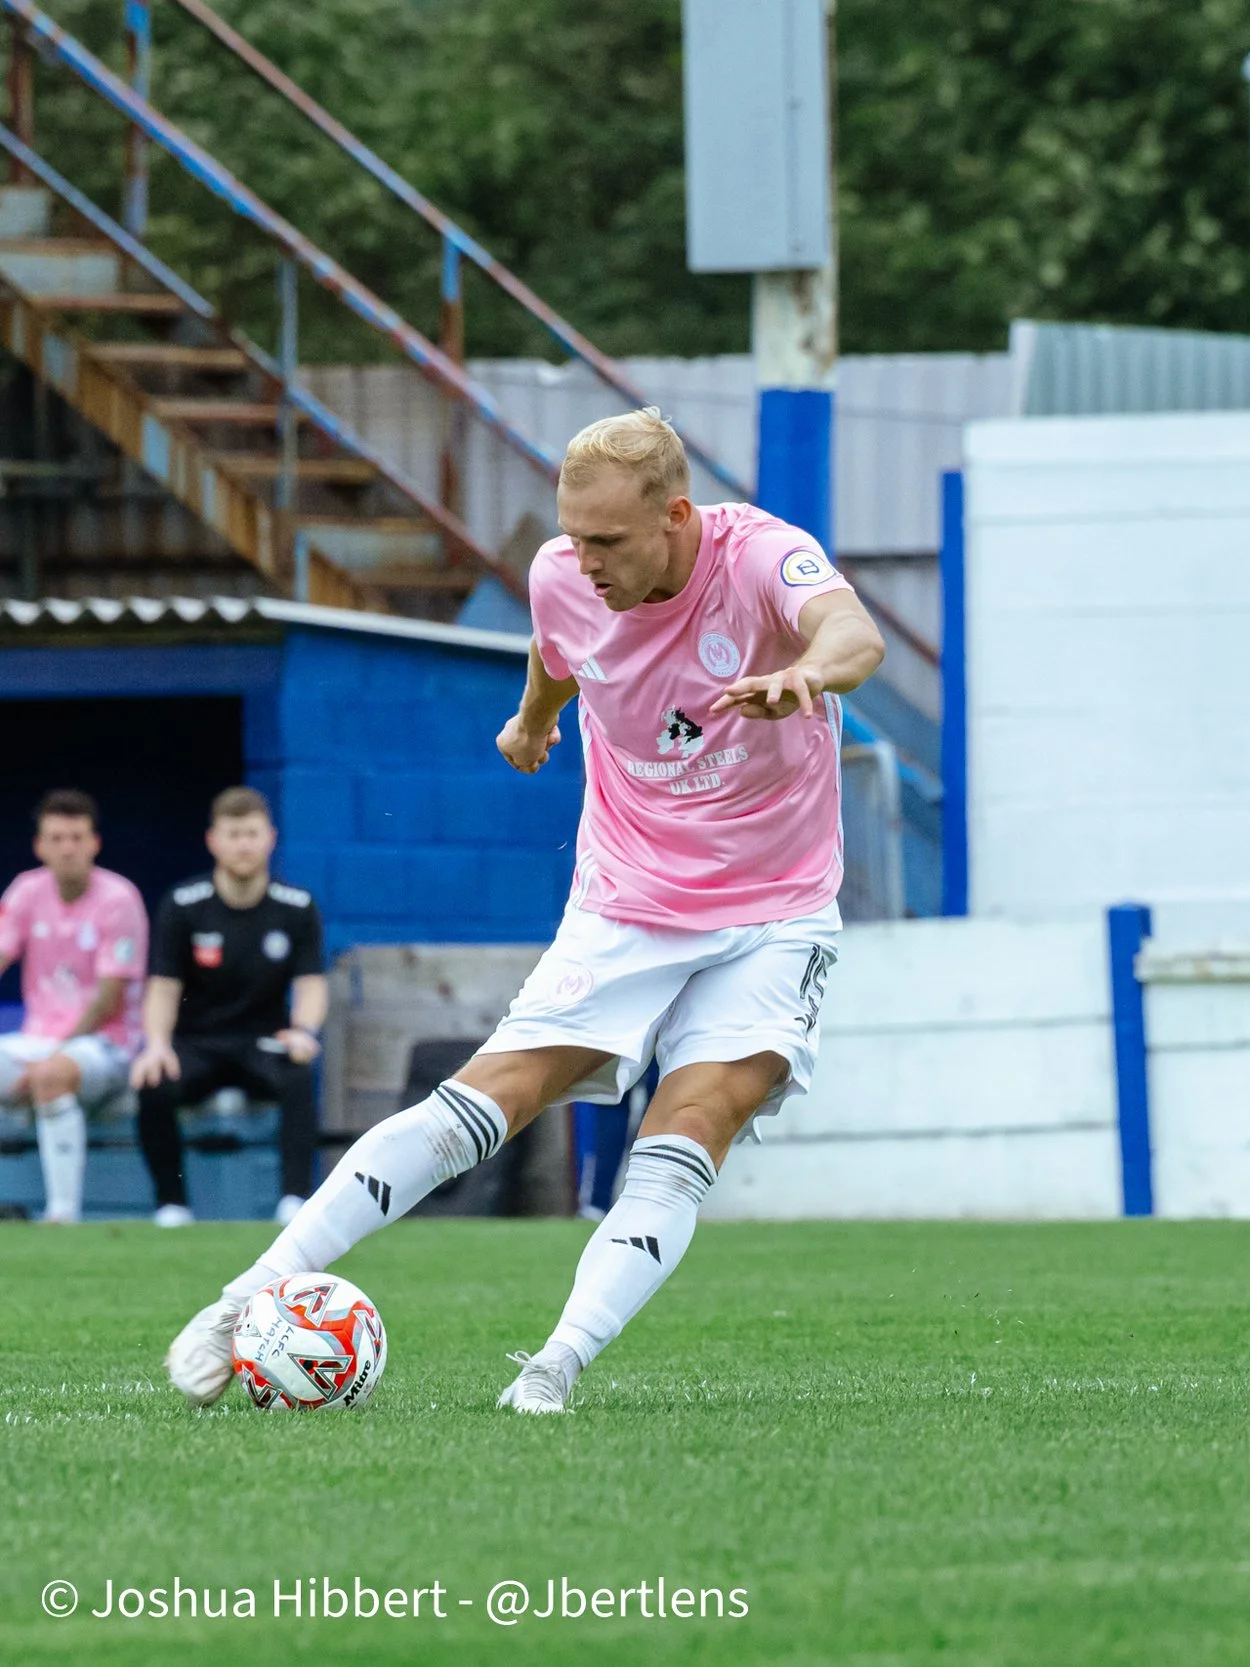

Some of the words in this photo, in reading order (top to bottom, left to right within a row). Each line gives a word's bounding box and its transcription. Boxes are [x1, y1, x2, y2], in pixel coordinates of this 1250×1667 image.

[627, 760, 694, 777] REGIONAL
[697, 745, 749, 770] STEELS
[669, 780, 693, 795] UK
